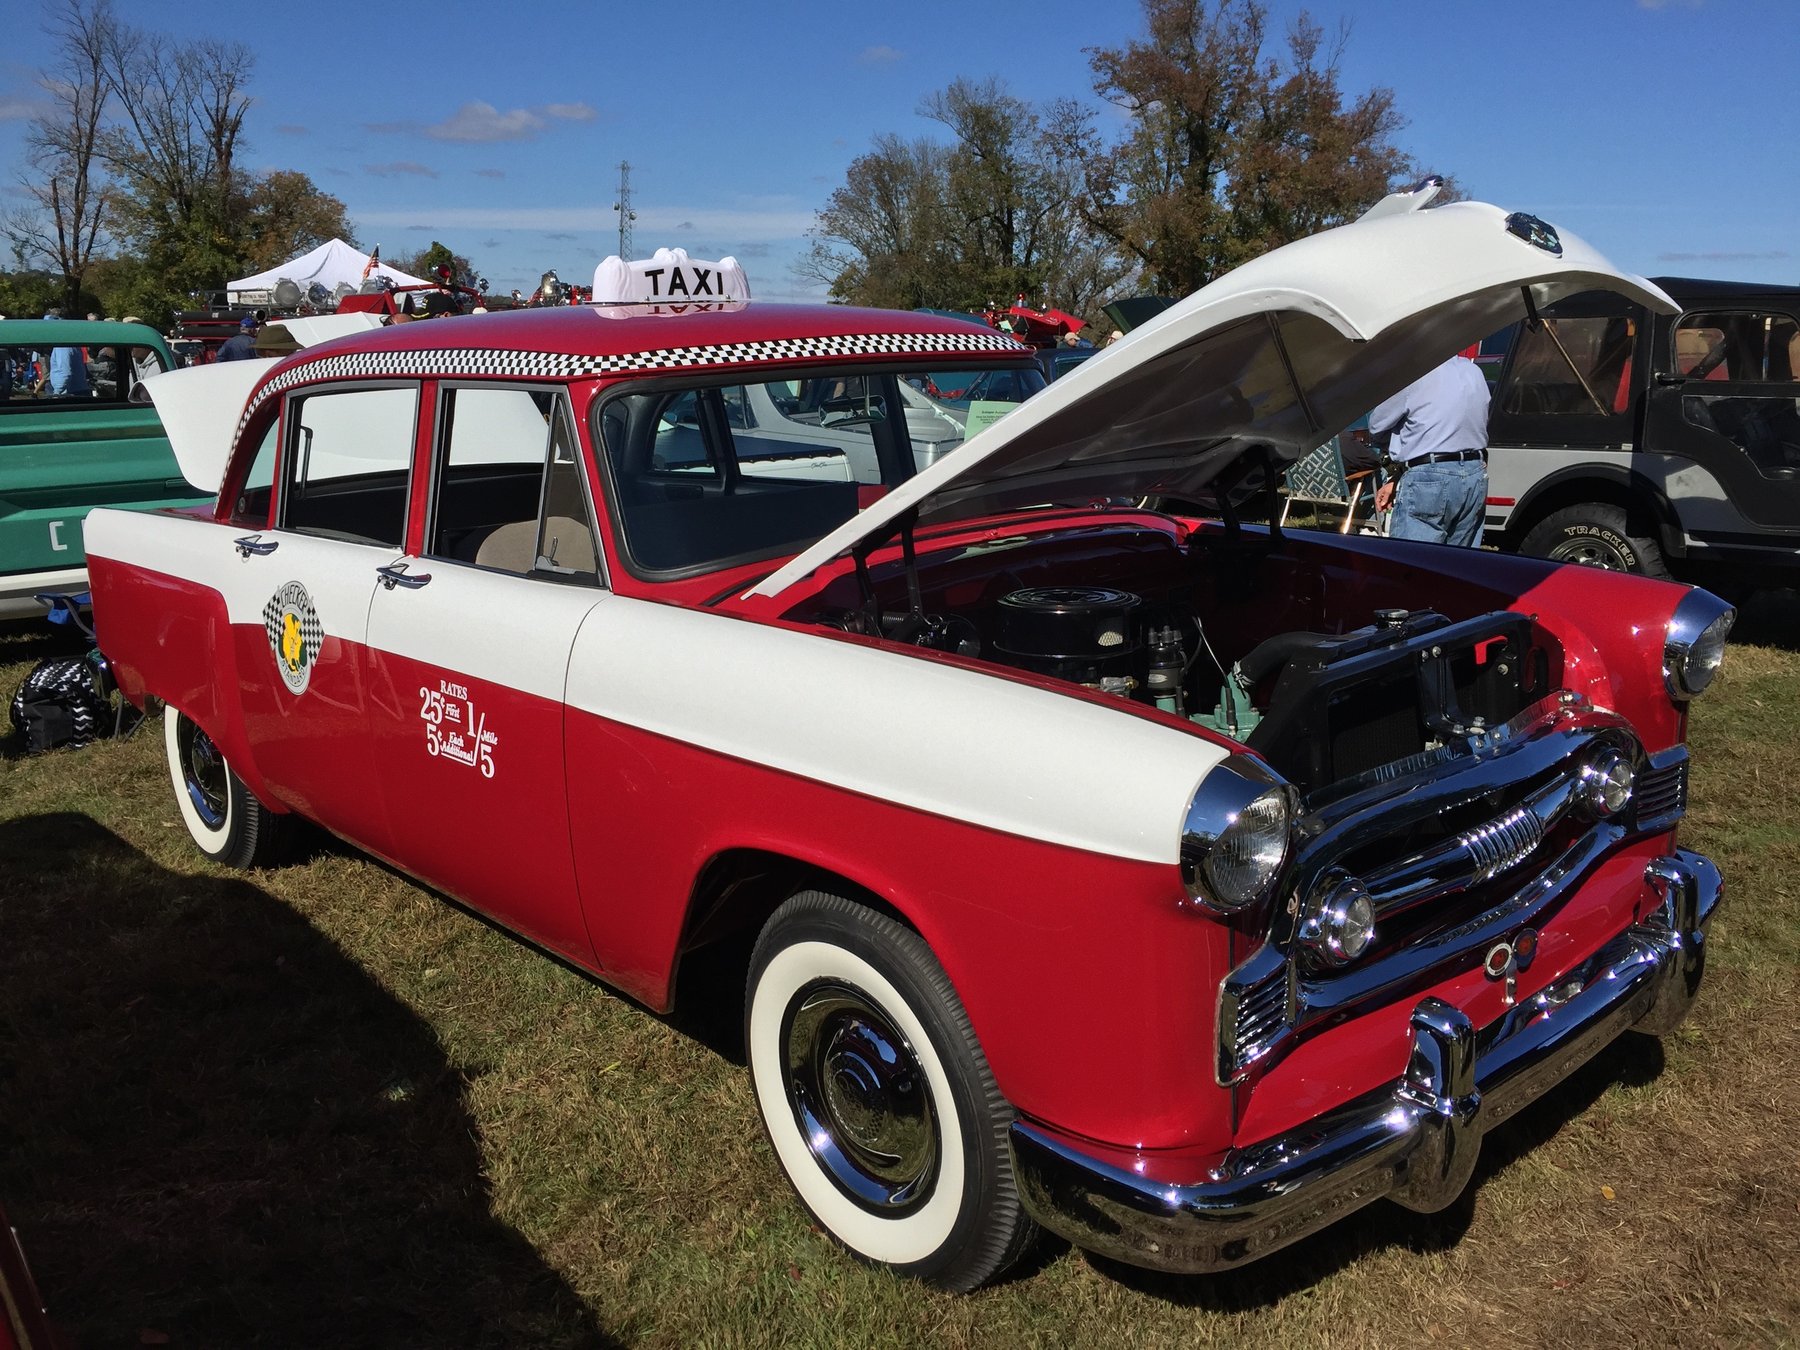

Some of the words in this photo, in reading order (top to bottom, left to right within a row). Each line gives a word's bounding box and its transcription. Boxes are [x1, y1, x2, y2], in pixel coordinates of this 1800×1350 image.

[645, 267, 724, 296] TAXI
[1564, 526, 1636, 566] TRACKER
[281, 585, 308, 611] CHECKER
[440, 680, 467, 700] RATES
[420, 687, 445, 724] 25¢
[481, 729, 498, 745] Mile
[426, 722, 442, 756] 5¢
[449, 732, 464, 747] Each
[440, 741, 473, 762] Additional
